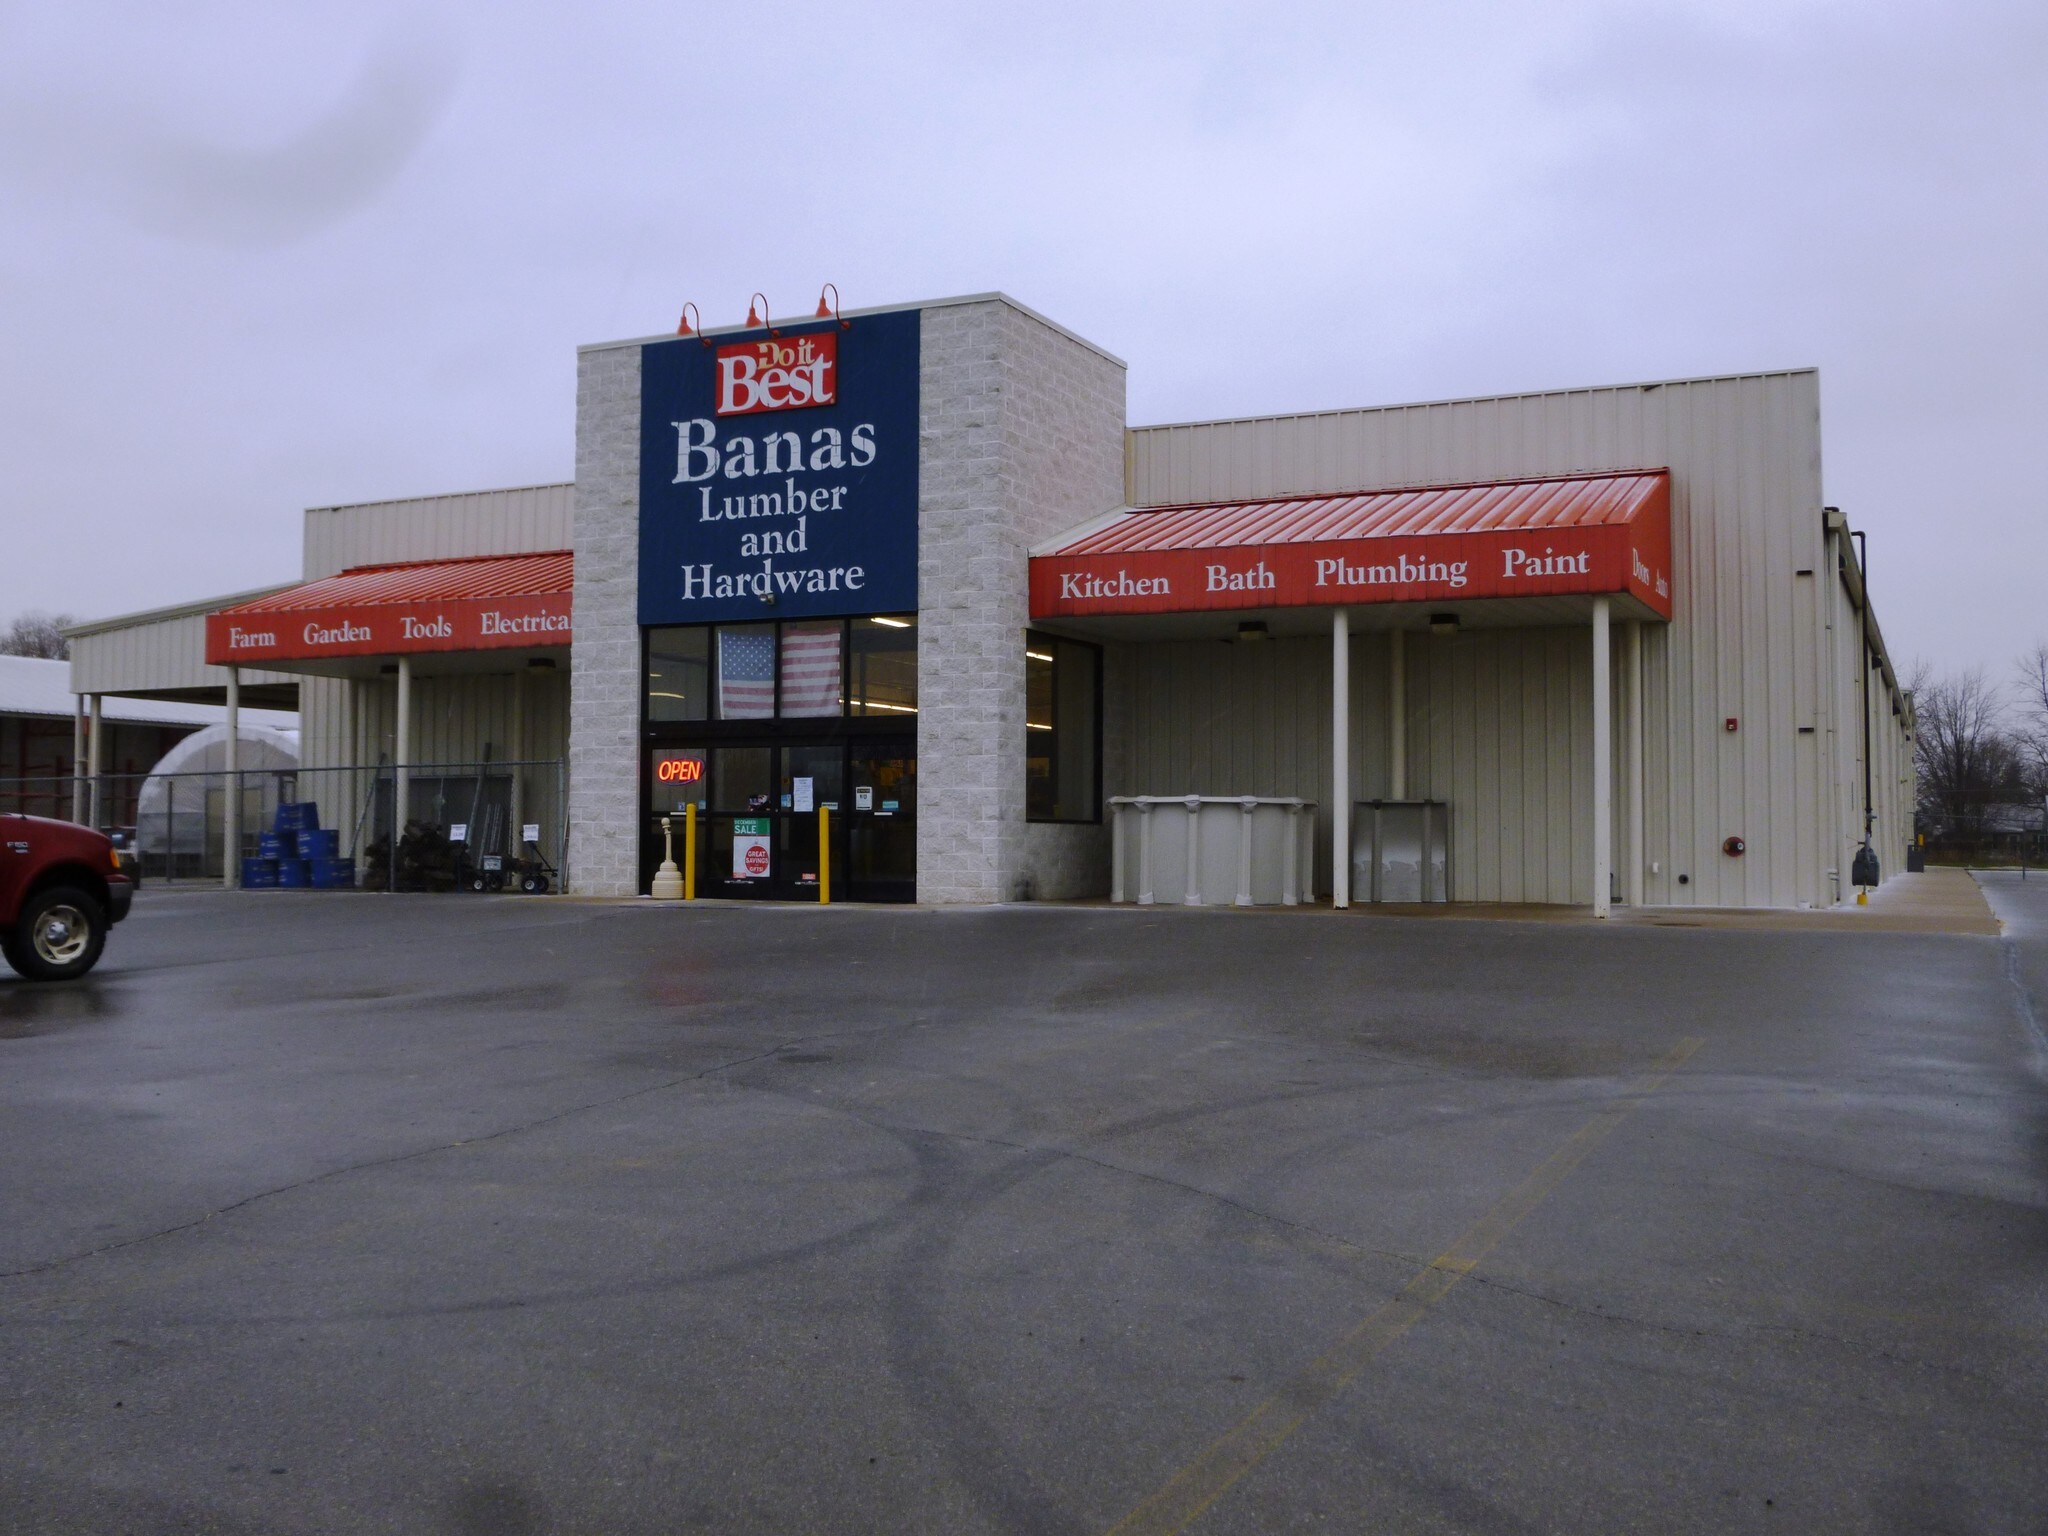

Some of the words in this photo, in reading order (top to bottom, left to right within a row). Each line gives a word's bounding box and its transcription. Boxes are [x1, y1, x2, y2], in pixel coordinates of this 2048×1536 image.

[757, 342, 795, 370] Do
[797, 338, 815, 365] it
[718, 353, 832, 413] Best
[671, 418, 876, 484] Banas
[699, 478, 847, 522] Lumber
[740, 516, 808, 557] and
[681, 558, 864, 601] Hardware
[1059, 570, 1171, 600] Kitchen
[1206, 561, 1276, 593] Bath
[1315, 555, 1467, 588] Plumbing
[1502, 547, 1591, 579] Paint
[229, 626, 276, 649] Farm
[303, 620, 371, 645] Garden
[400, 614, 452, 640] Tools
[658, 760, 701, 781] OPEN
[734, 825, 757, 834] SALE
